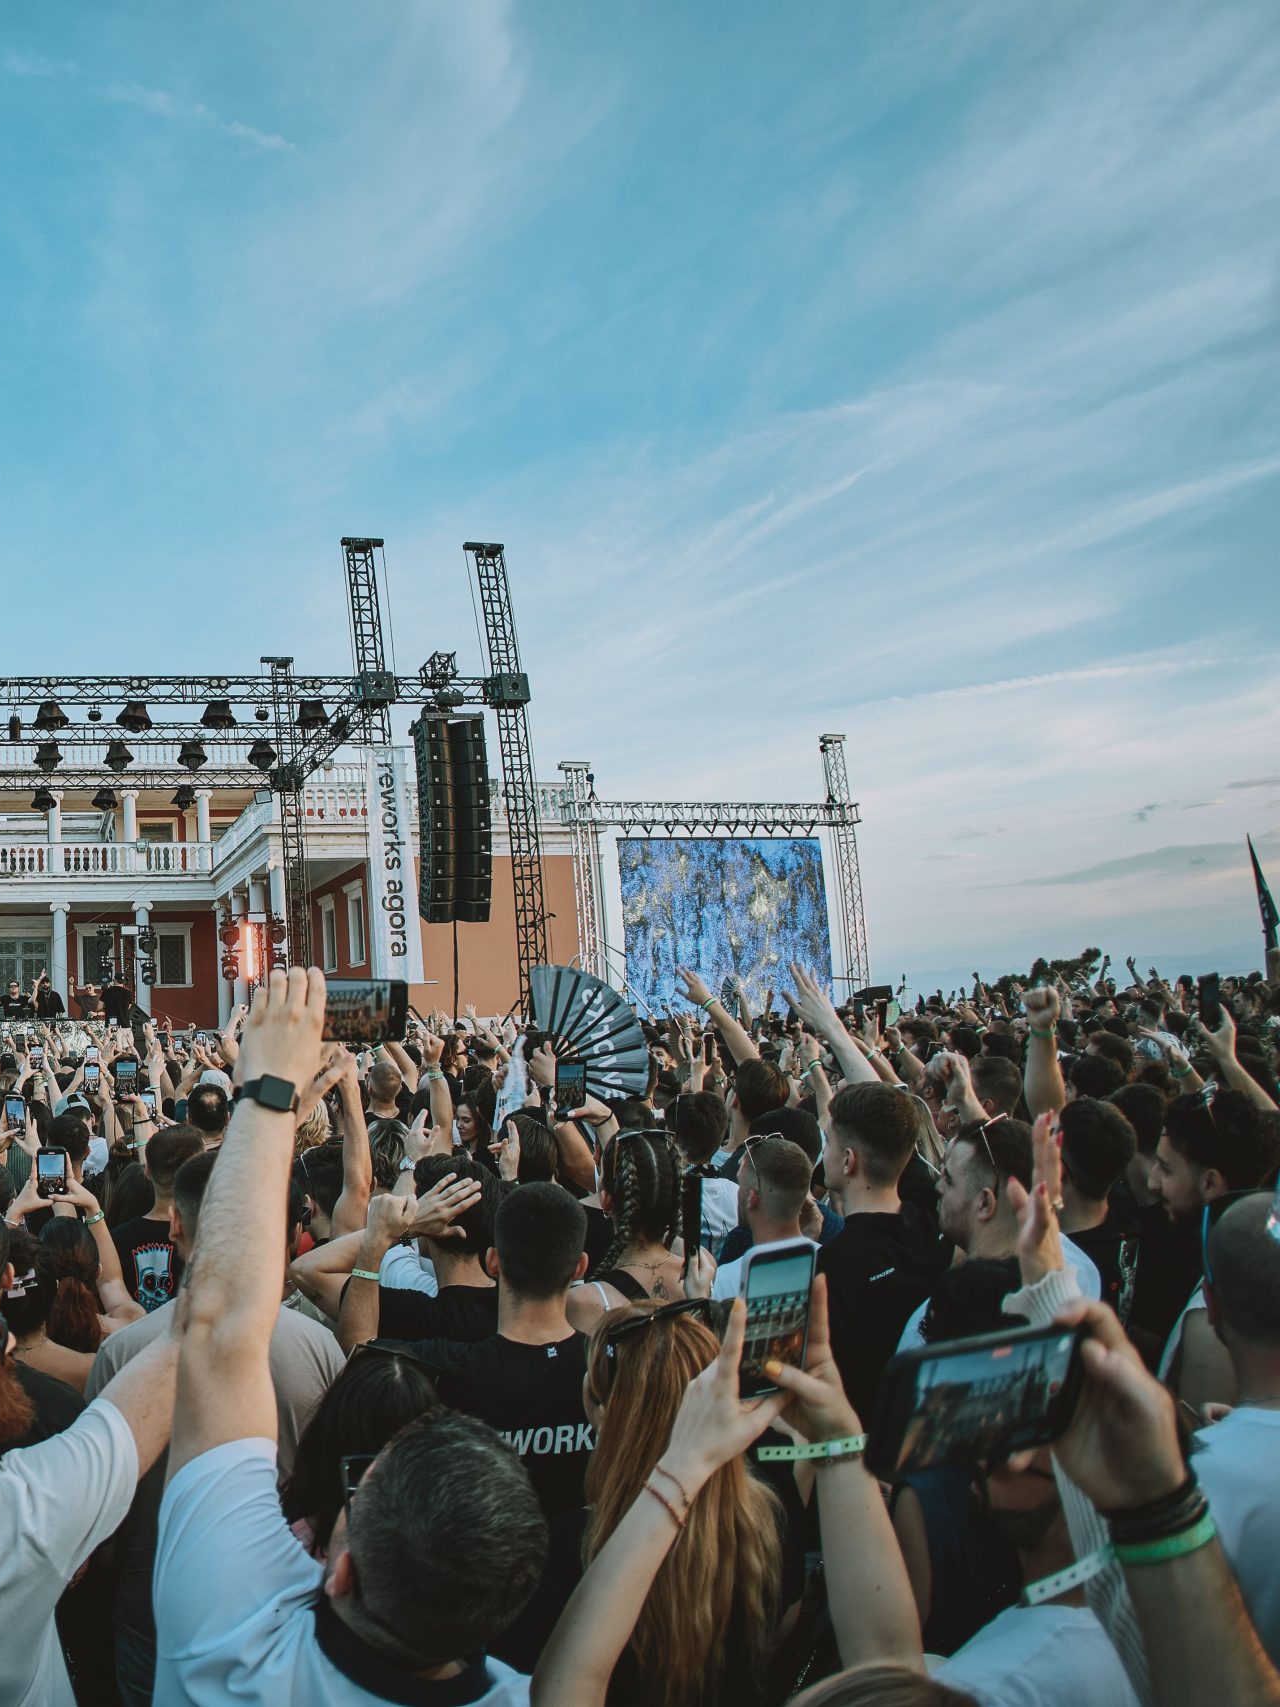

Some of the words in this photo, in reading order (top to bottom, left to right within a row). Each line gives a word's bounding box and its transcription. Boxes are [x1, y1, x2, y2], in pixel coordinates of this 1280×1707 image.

[377, 762, 407, 871] reworks
[382, 879, 408, 957] agora
[497, 1423, 599, 1456] WORK
